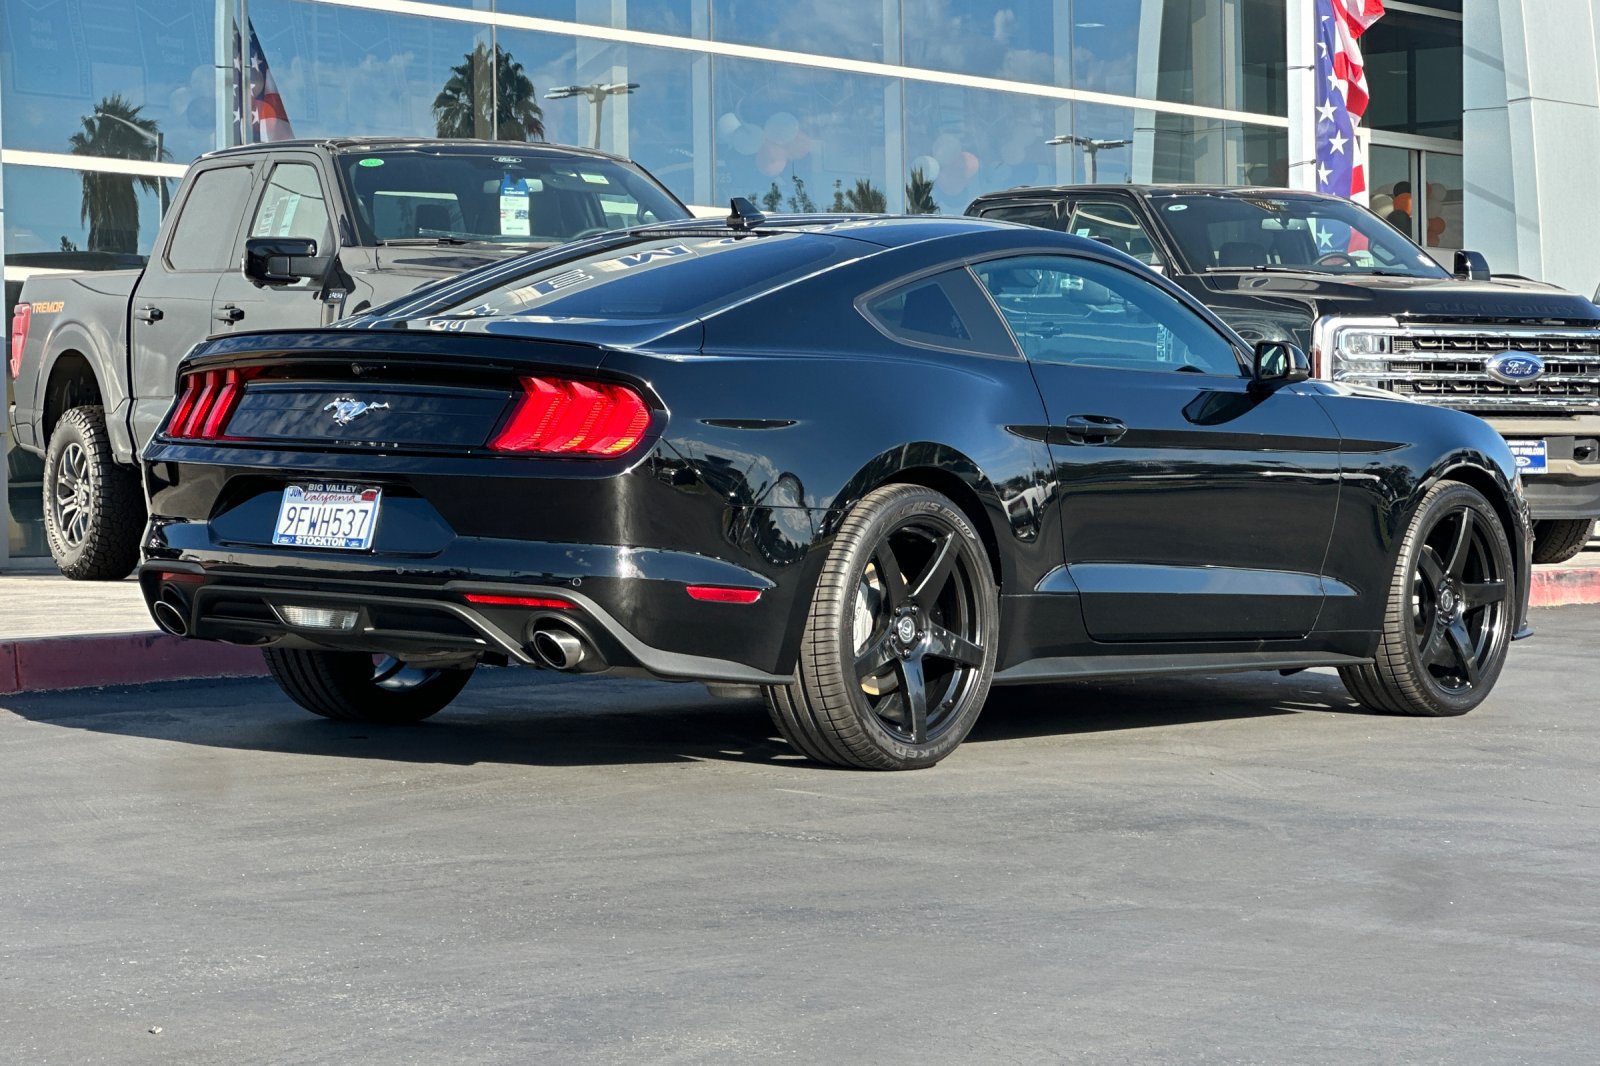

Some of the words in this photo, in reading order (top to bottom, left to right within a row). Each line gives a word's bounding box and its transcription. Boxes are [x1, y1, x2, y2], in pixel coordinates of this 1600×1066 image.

[32, 302, 64, 314] TREMOR
[1505, 360, 1532, 374] Ford
[304, 491, 357, 504] California
[283, 506, 369, 537] 9FWH537
[295, 536, 347, 547] STOCKTON
